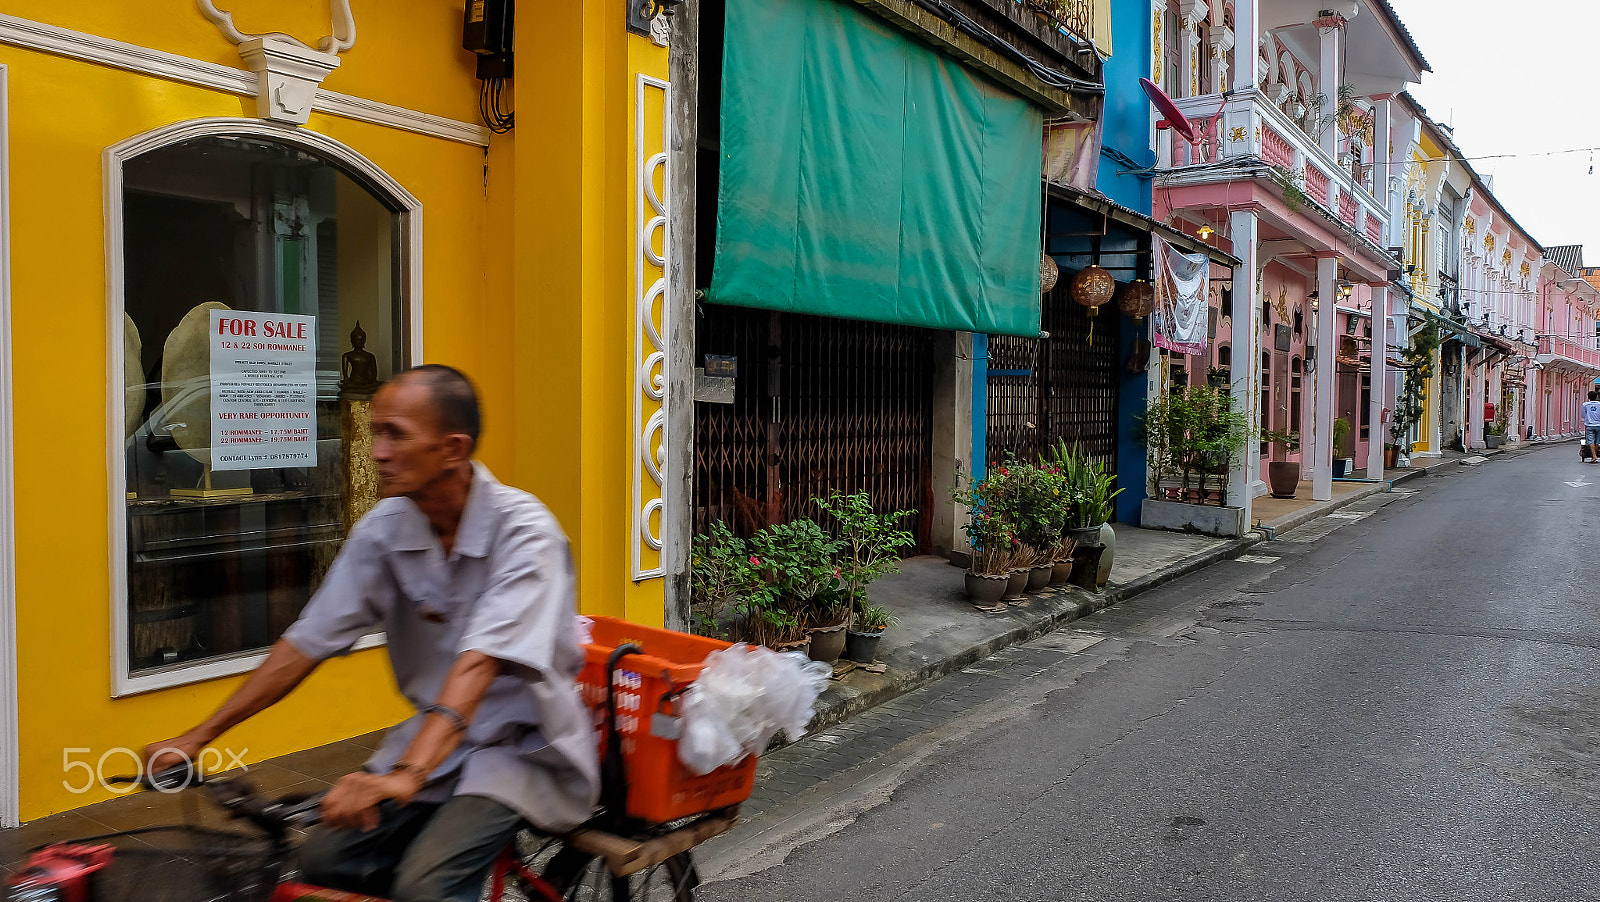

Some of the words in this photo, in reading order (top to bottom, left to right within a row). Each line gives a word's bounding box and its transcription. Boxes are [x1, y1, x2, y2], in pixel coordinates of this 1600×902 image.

[219, 318, 256, 336] FOR
[263, 320, 307, 339] SALE
[221, 341, 231, 349] 12
[241, 342, 251, 350] 22
[267, 343, 306, 352] ROMMANEE
[218, 412, 238, 420] VERY
[239, 412, 259, 420] RARE
[260, 412, 309, 420] OPPORTUNITY
